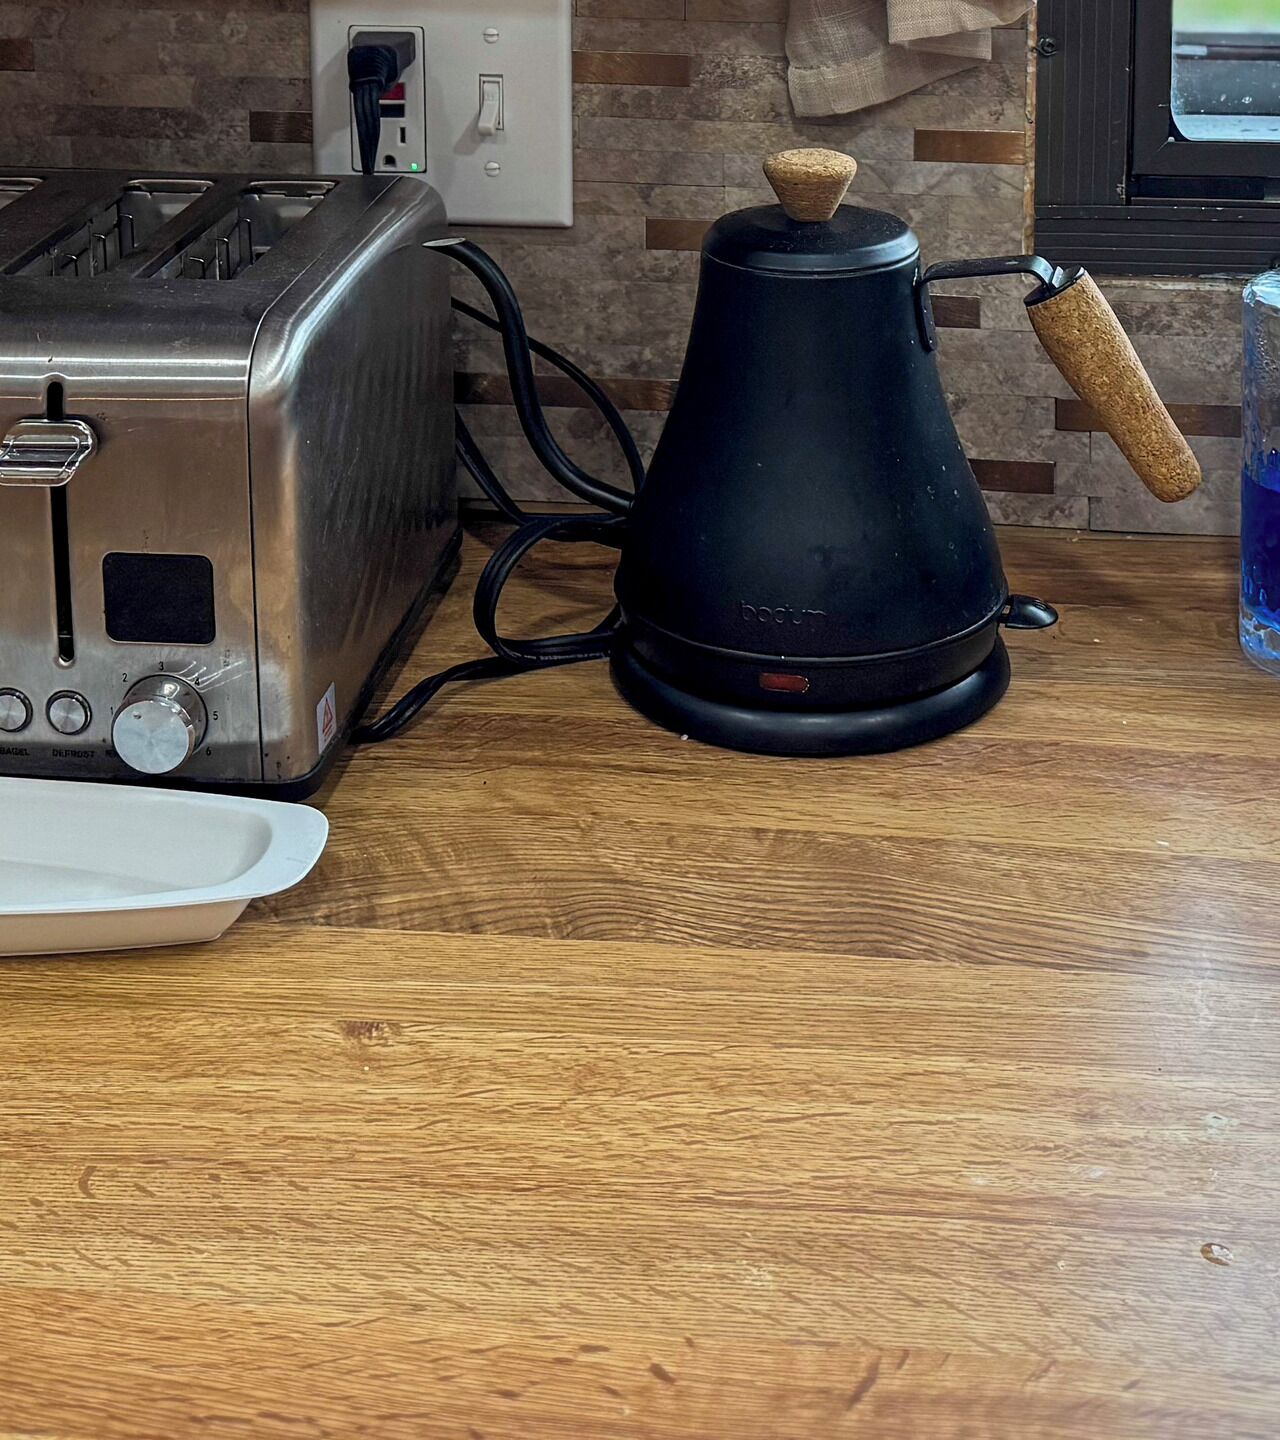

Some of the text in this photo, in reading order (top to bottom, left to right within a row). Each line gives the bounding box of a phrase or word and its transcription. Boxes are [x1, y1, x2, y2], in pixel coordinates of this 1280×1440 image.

[158, 661, 164, 671] 3
[122, 672, 128, 682] 2
[194, 677, 200, 686] 4
[212, 711, 218, 721] 5
[0, 746, 30, 756] BAGEL
[52, 748, 95, 758] DEFROST
[205, 746, 212, 756] 6
